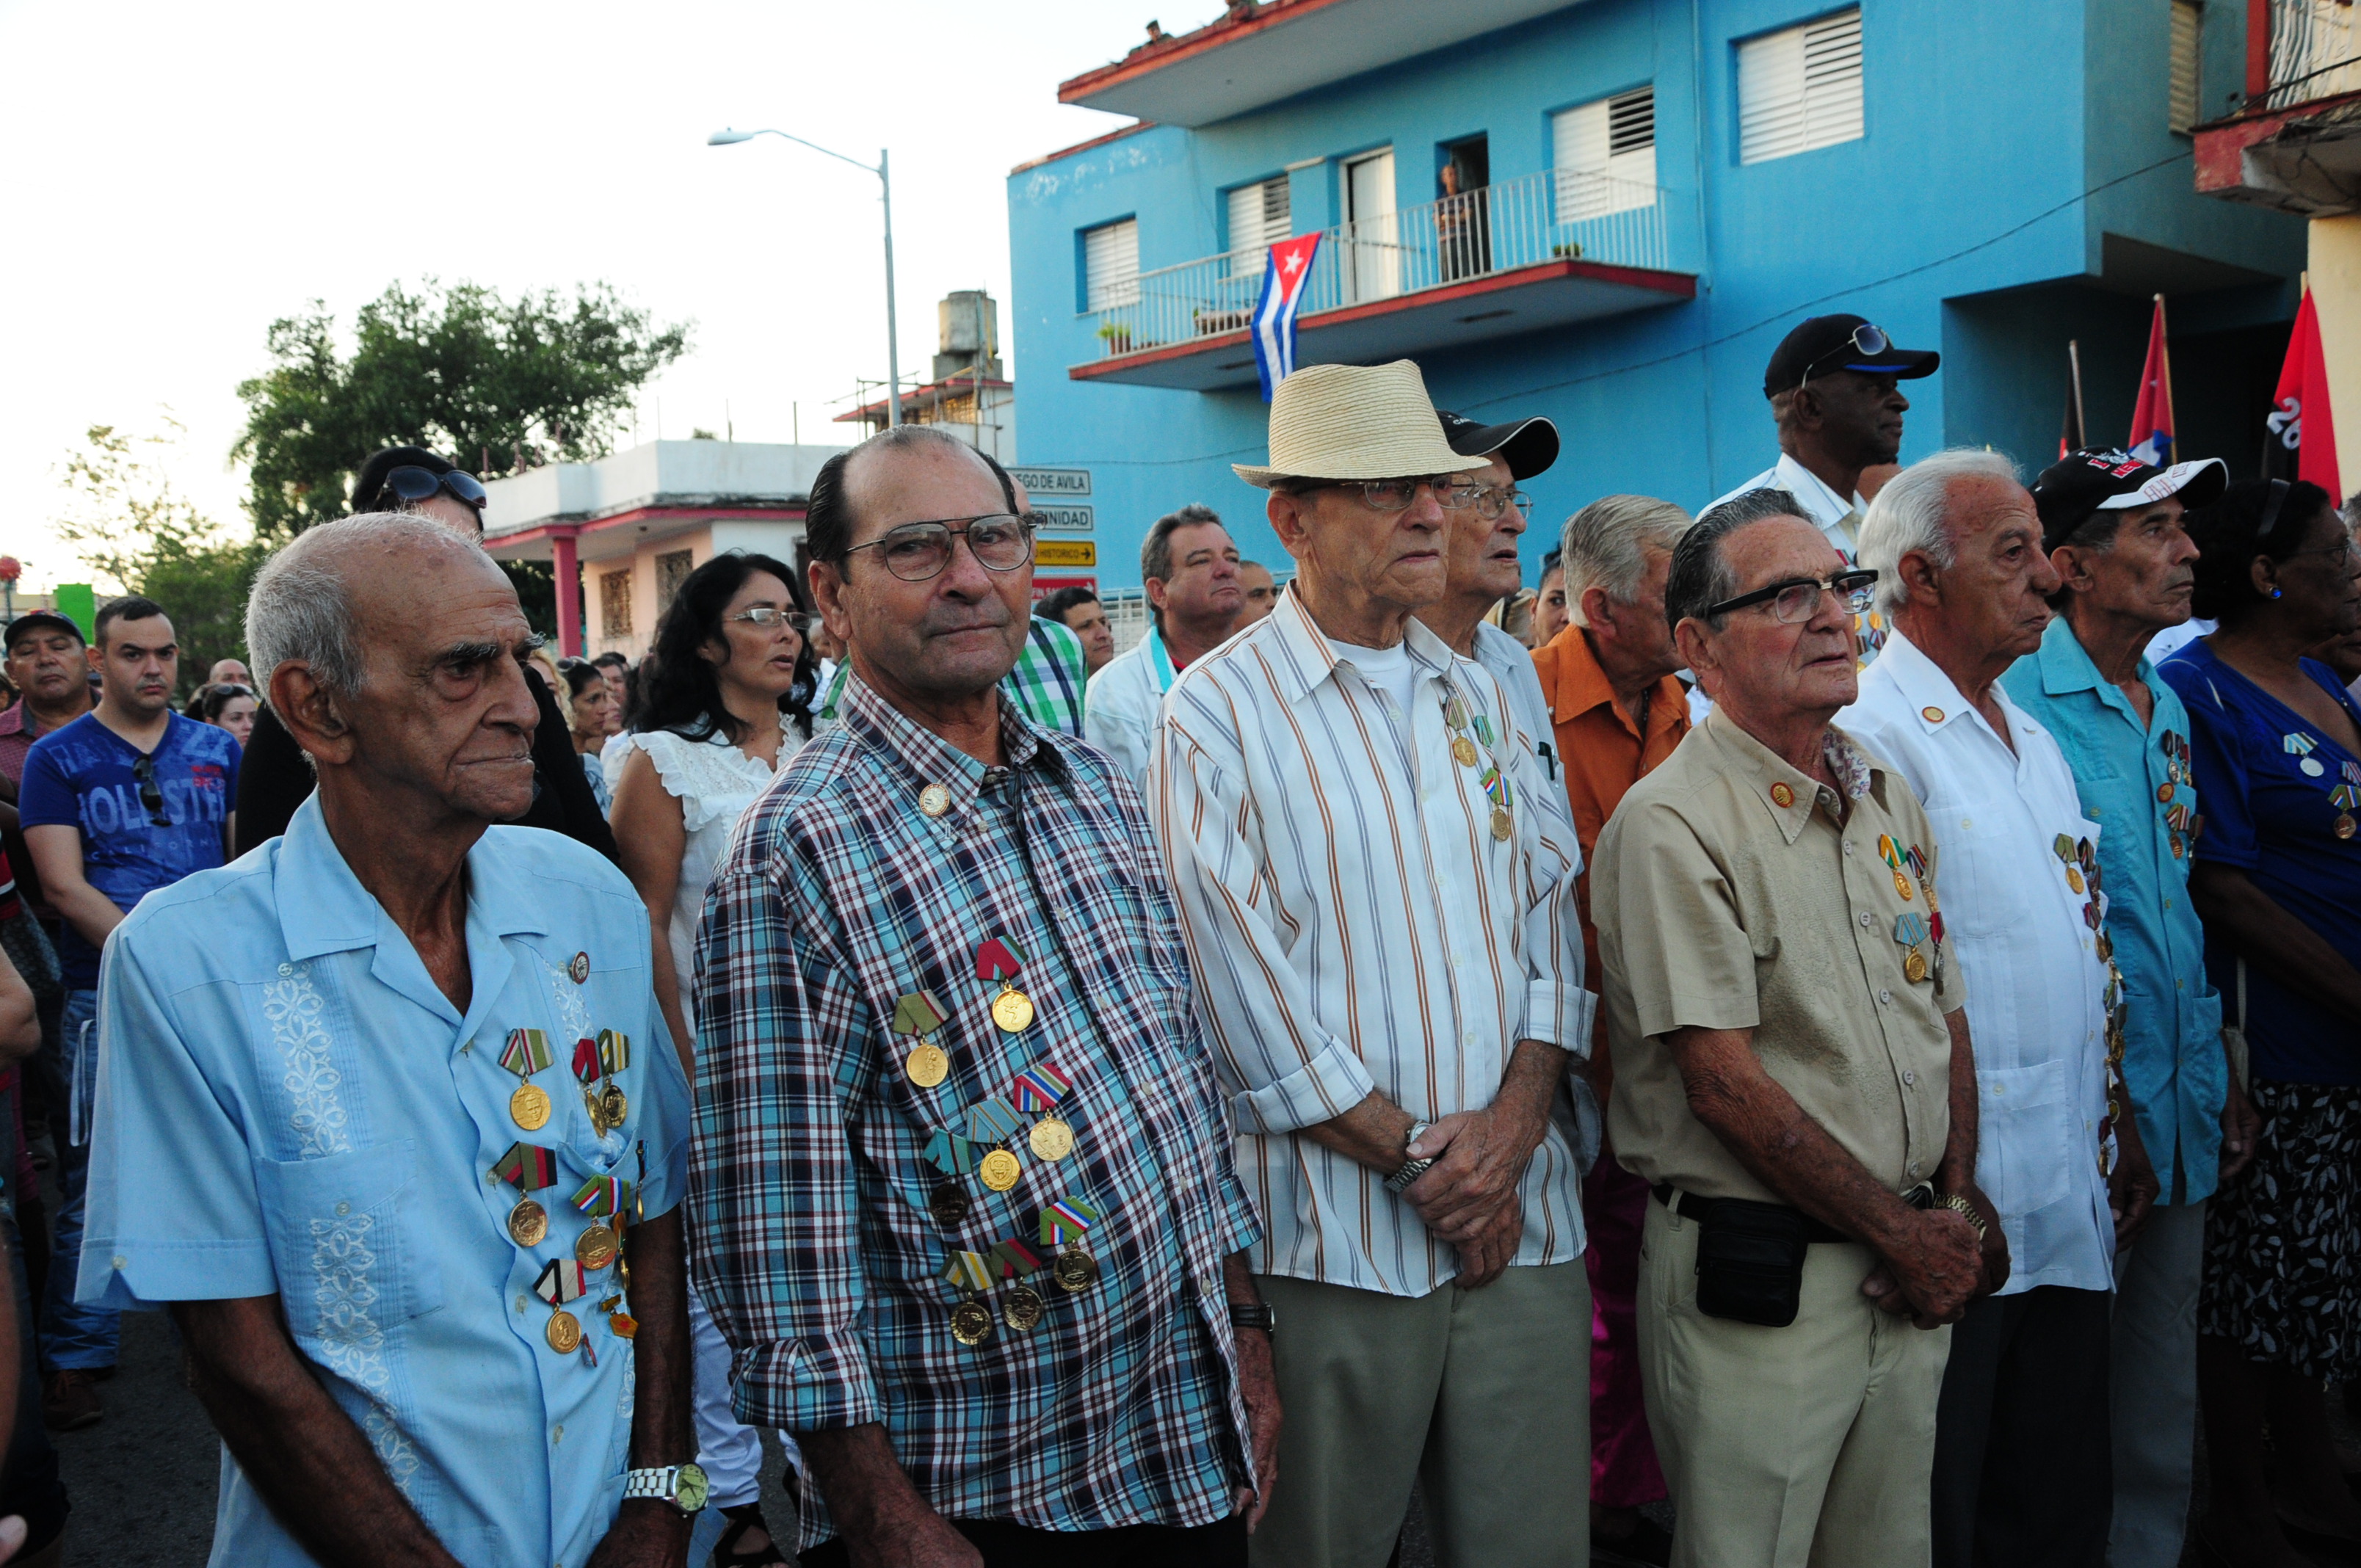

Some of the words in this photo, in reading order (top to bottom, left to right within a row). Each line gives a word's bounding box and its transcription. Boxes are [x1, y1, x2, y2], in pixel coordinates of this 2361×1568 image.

[2266, 396, 2301, 451] 26
[1014, 473, 1038, 488] EGO
[1040, 474, 1053, 488] DE
[1056, 475, 1086, 490] AVILA
[76, 778, 226, 838] HOLLSTE
